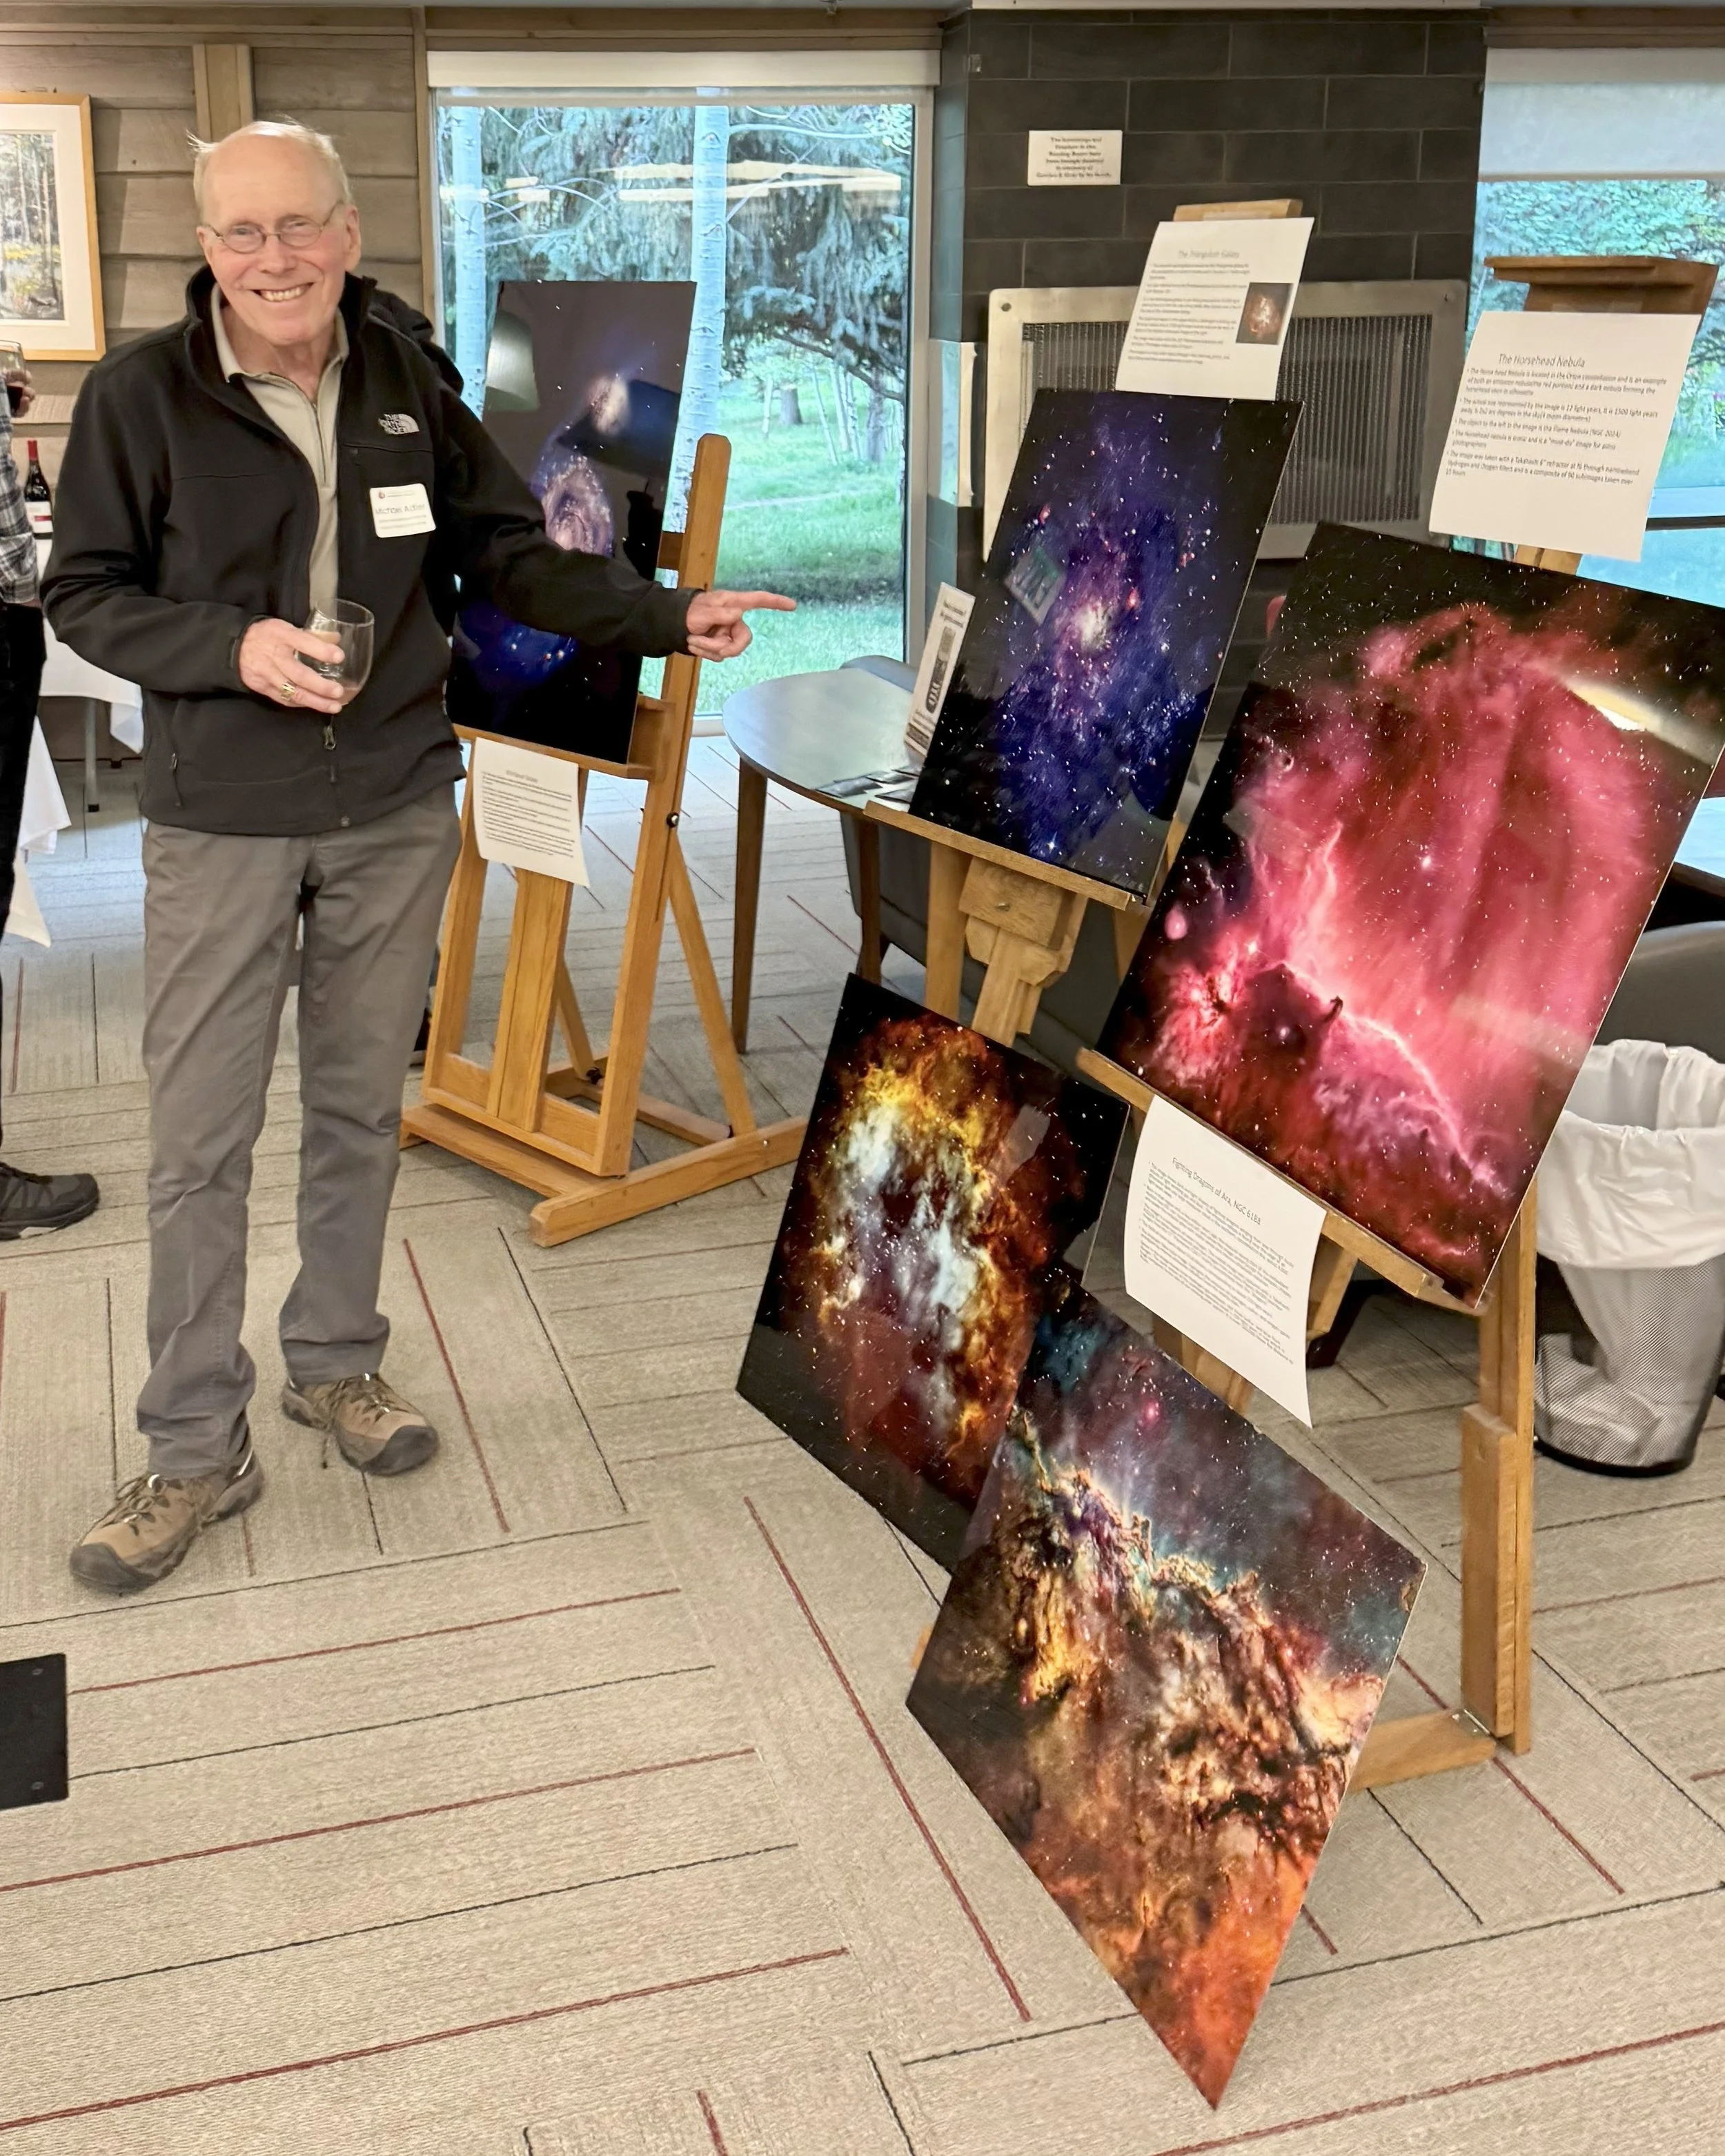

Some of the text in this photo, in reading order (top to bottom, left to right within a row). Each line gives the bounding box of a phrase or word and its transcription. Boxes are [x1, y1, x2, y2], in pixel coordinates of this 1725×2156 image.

[1499, 353, 1585, 368] The Horsehead Nebula
[1233, 1199, 1246, 1215] NGC
